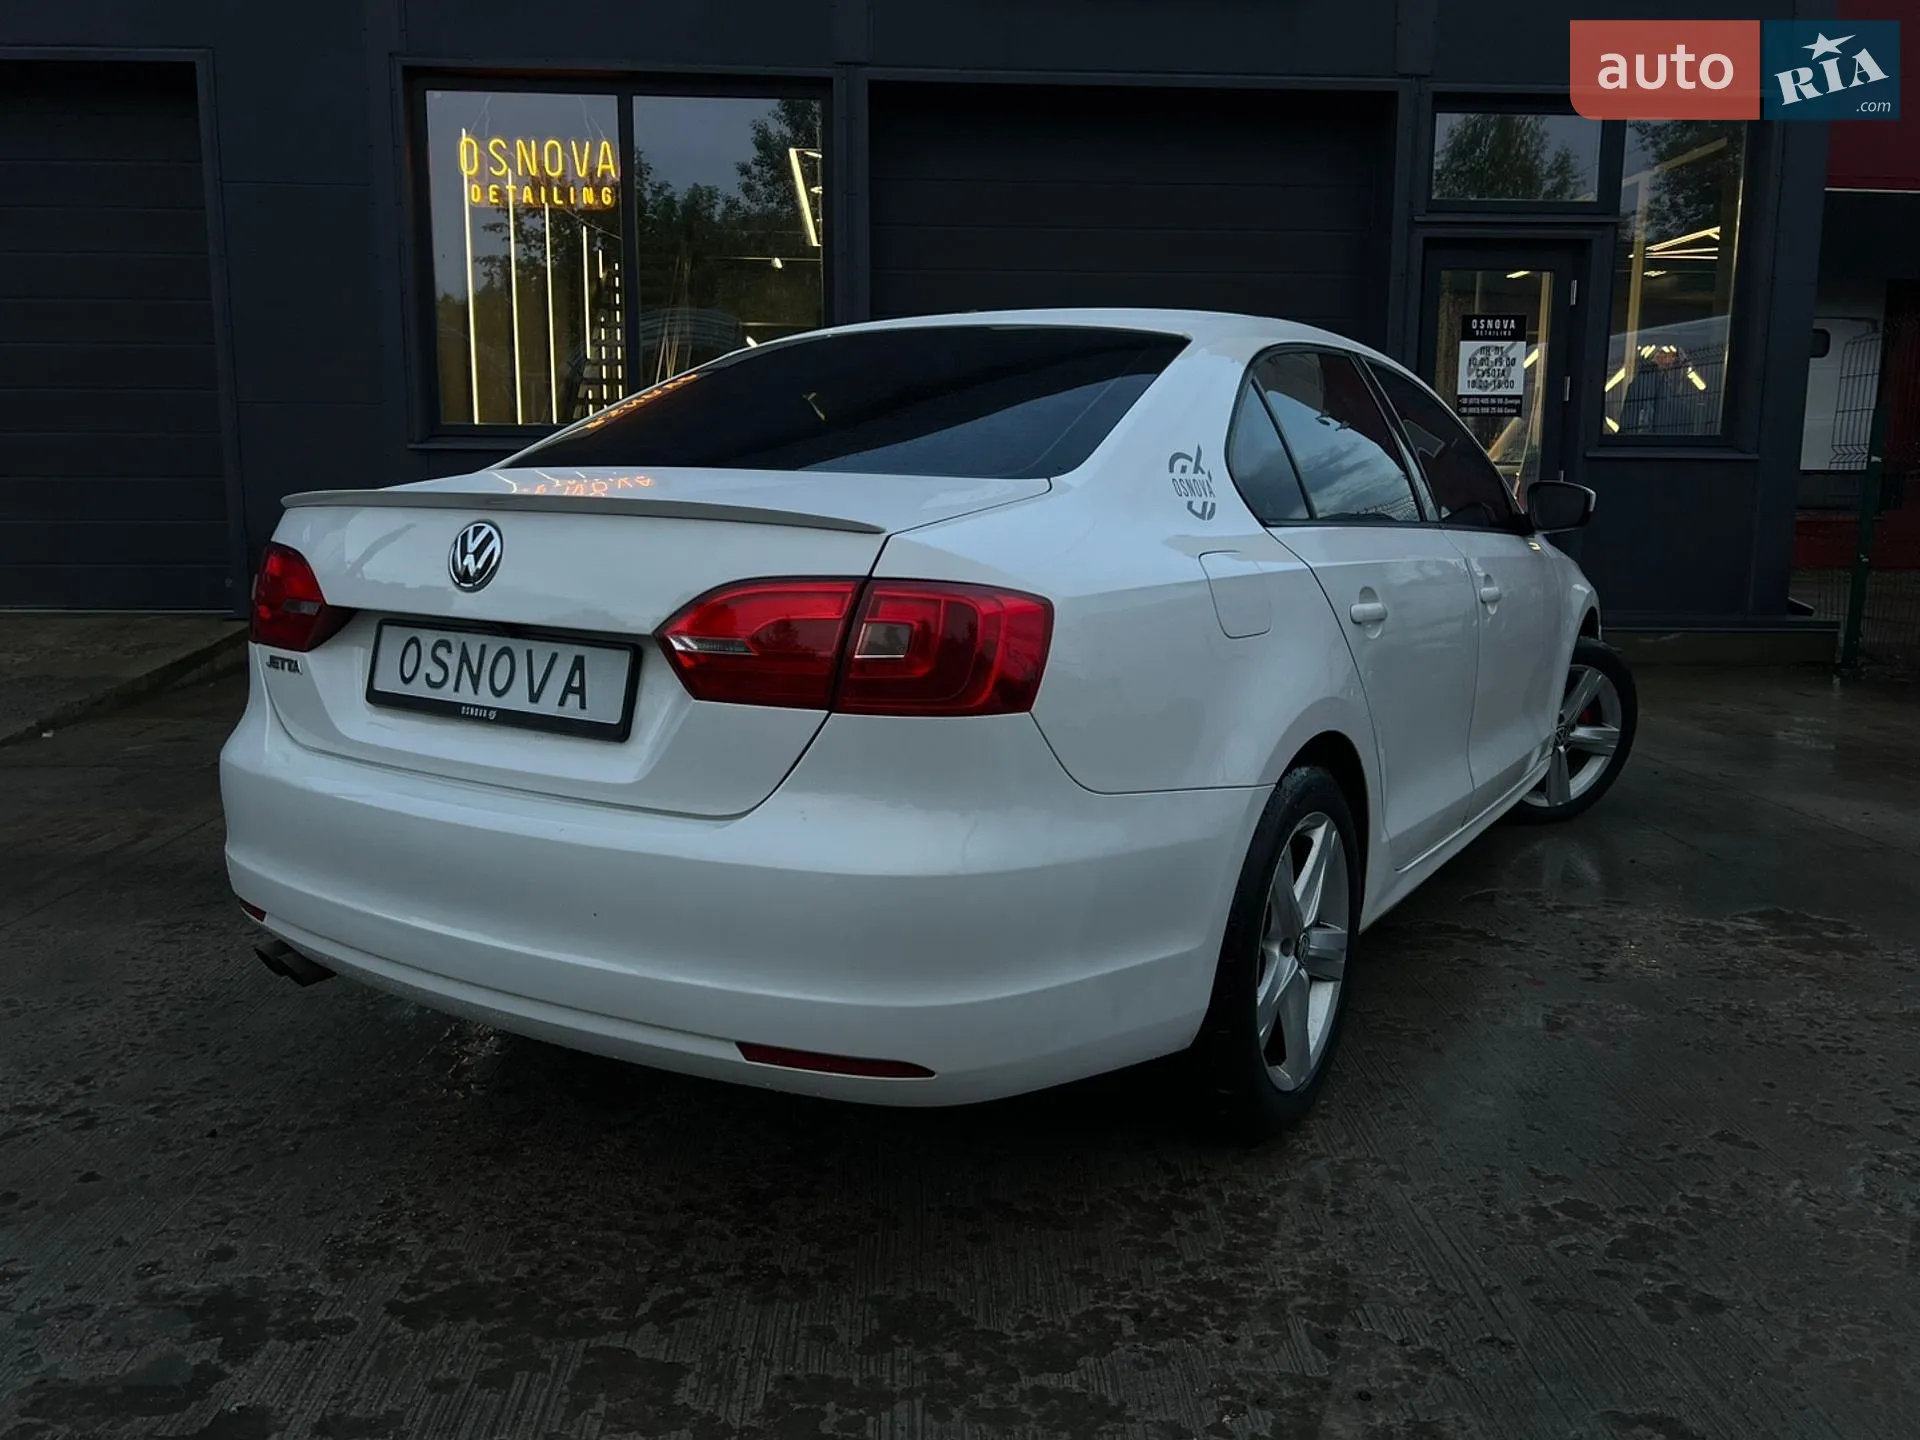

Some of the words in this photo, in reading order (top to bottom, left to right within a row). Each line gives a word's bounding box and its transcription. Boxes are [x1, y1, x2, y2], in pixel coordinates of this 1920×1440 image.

[459, 136, 618, 179] OSNOVA
[470, 183, 615, 206] DETAILING
[1471, 319, 1516, 330] OSNOVA
[1171, 477, 1216, 498] OSNOVA
[266, 654, 303, 675] JETTA
[399, 635, 587, 711] OSNOVA
